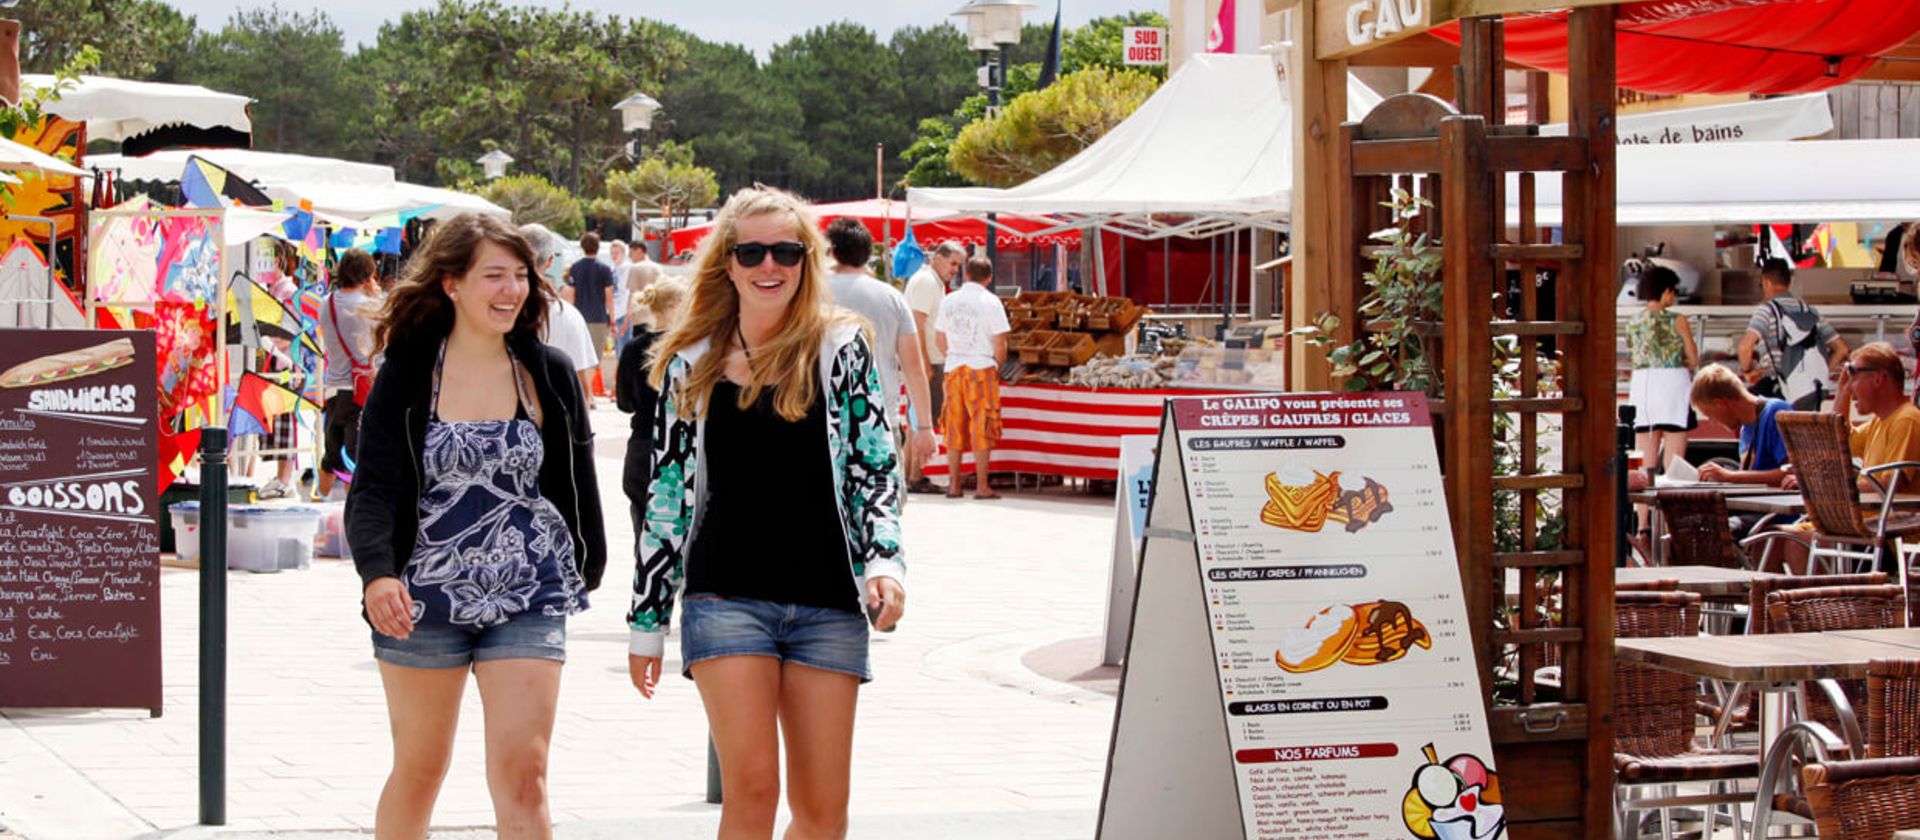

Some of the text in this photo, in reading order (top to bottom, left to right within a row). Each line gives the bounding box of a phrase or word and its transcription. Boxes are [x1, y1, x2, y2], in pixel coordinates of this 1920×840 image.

[1135, 30, 1157, 44] SUD
[1128, 47, 1162, 61] OUEST
[1660, 127, 1682, 144] de
[1692, 125, 1744, 143] bains
[1203, 398, 1404, 411] Le GALIPO vous présente ses
[1200, 412, 1259, 427] CRÊPES
[1270, 414, 1341, 426] GAUFRES
[1351, 412, 1410, 424] GLACES
[1194, 440, 1211, 449] LES
[1213, 438, 1251, 449] GAUFRES
[1262, 438, 1295, 448] WAFFLE
[1305, 437, 1338, 447] WAFFEL
[1245, 699, 1371, 713] GLACES EN CORNET OU EN POT
[1274, 747, 1360, 760] NOS PARFUMS
